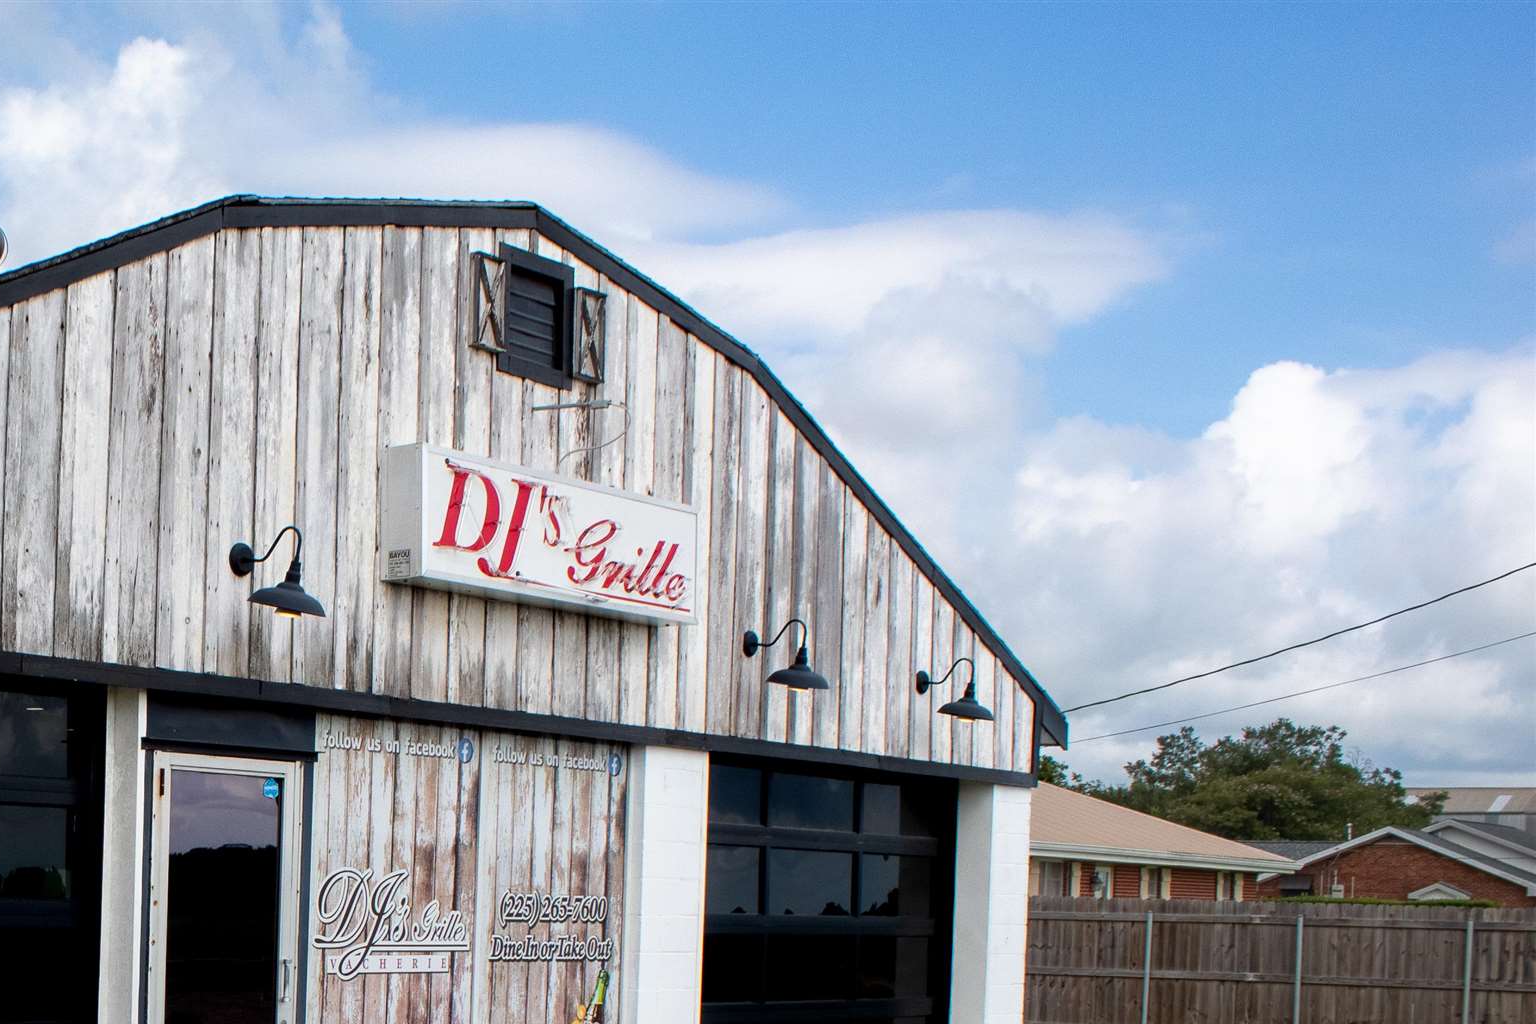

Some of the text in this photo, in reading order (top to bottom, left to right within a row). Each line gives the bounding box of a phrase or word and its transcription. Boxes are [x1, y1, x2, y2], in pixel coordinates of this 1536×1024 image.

[431, 463, 691, 602] DJ's Grille
[323, 730, 362, 750] follow
[367, 736, 381, 753] us
[385, 740, 400, 754] on
[405, 737, 456, 759] facebook
[493, 744, 527, 765] follow
[529, 752, 544, 767] us
[547, 755, 560, 769] on
[563, 752, 608, 773] facebook
[499, 889, 608, 928] (225) 265-7600
[313, 869, 467, 981] DJ's Grille
[489, 935, 613, 960] Dine In or Take Out
[330, 958, 447, 970] VACHERIE
